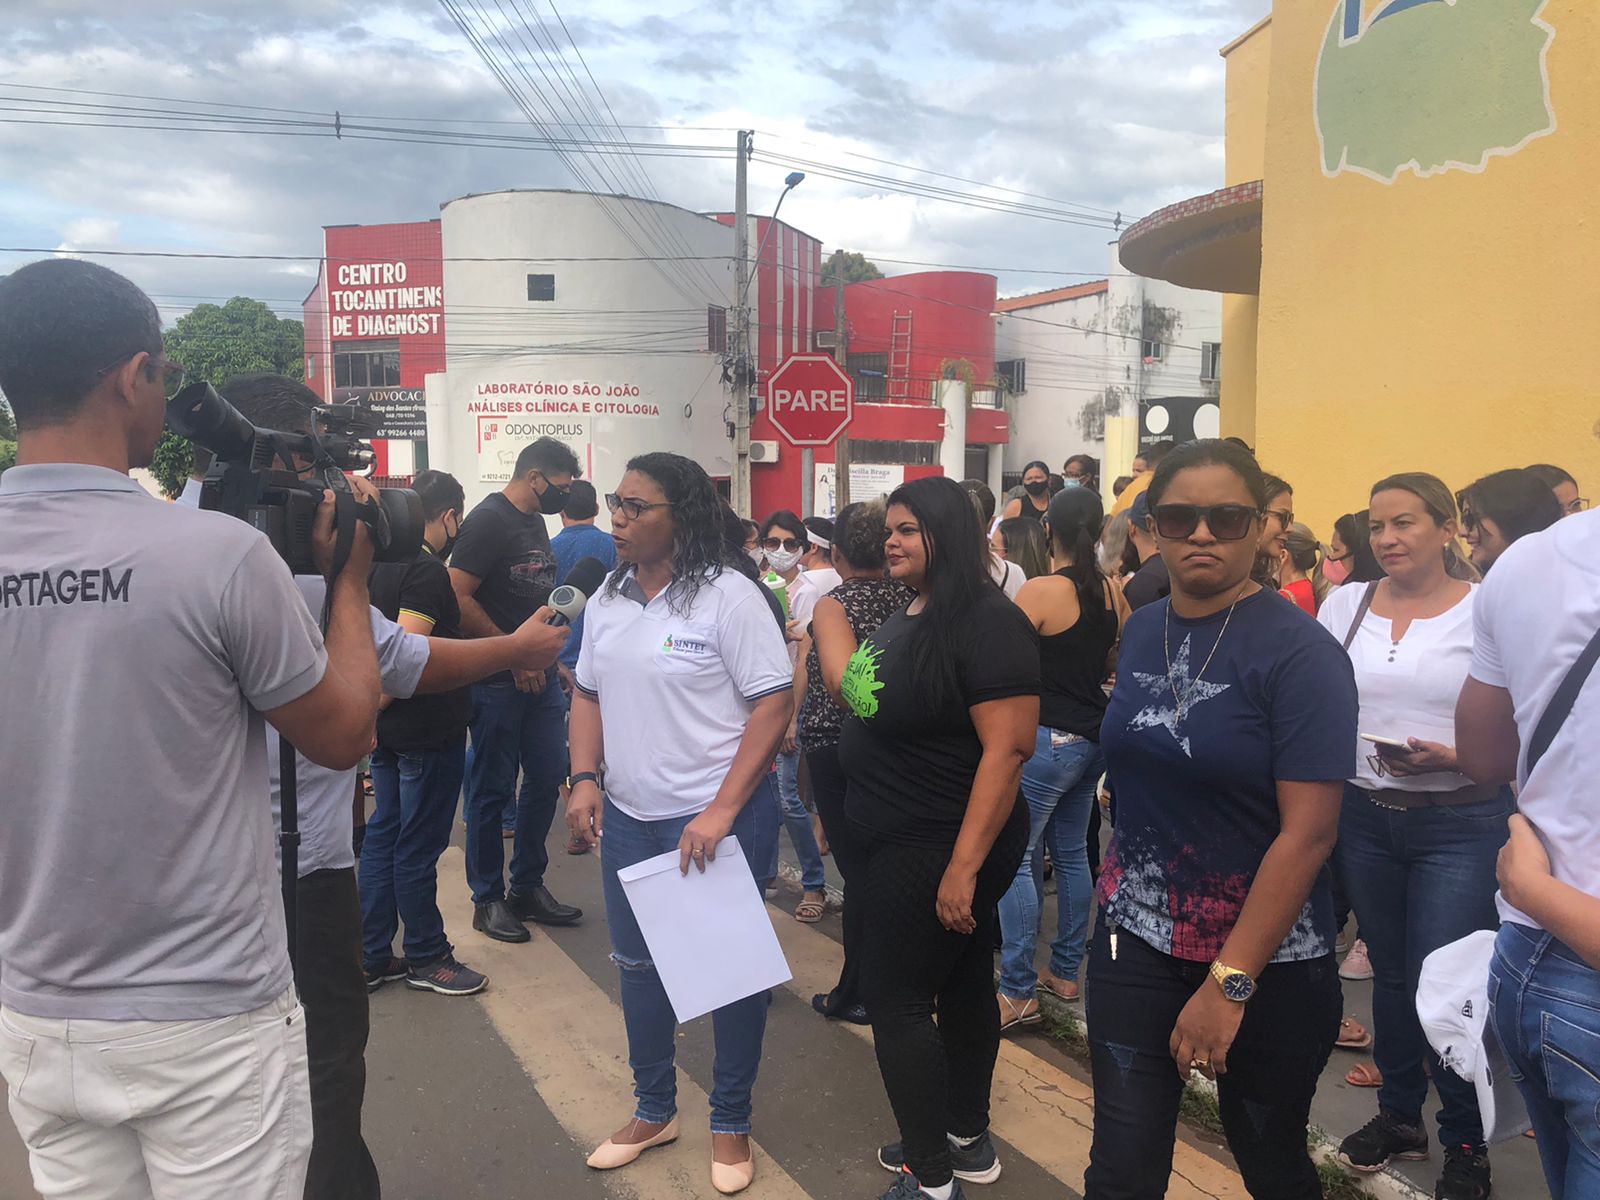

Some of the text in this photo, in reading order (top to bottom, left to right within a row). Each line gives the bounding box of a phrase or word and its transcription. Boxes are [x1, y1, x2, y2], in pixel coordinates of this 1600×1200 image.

[338, 262, 407, 286] CENTRO
[332, 315, 353, 336] DE
[477, 381, 640, 397] LABORATÓRIO SÃO JOÃO
[467, 399, 660, 416] ANÁLISES CLÍNICA E CITOLOGIA
[774, 389, 847, 412] PARE
[505, 424, 583, 435] ODONTOPLUS
[0, 567, 133, 609] RTAGEM
[673, 639, 707, 652] SINTET
